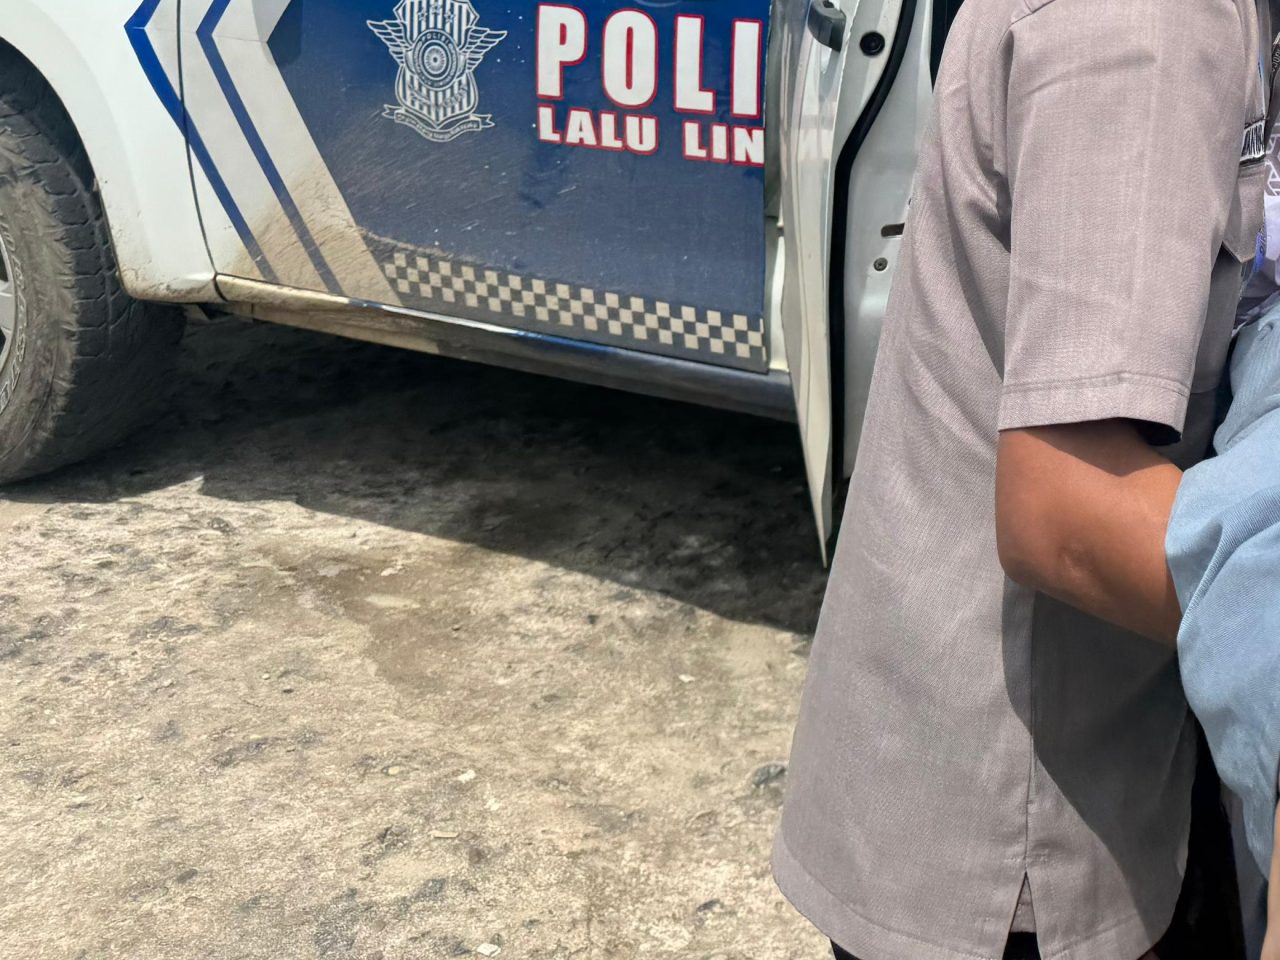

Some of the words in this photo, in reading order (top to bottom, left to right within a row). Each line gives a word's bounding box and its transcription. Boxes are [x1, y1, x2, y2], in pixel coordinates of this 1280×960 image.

[537, 3, 763, 119] POLI
[538, 104, 659, 155] LALU
[682, 120, 765, 167] LIN
